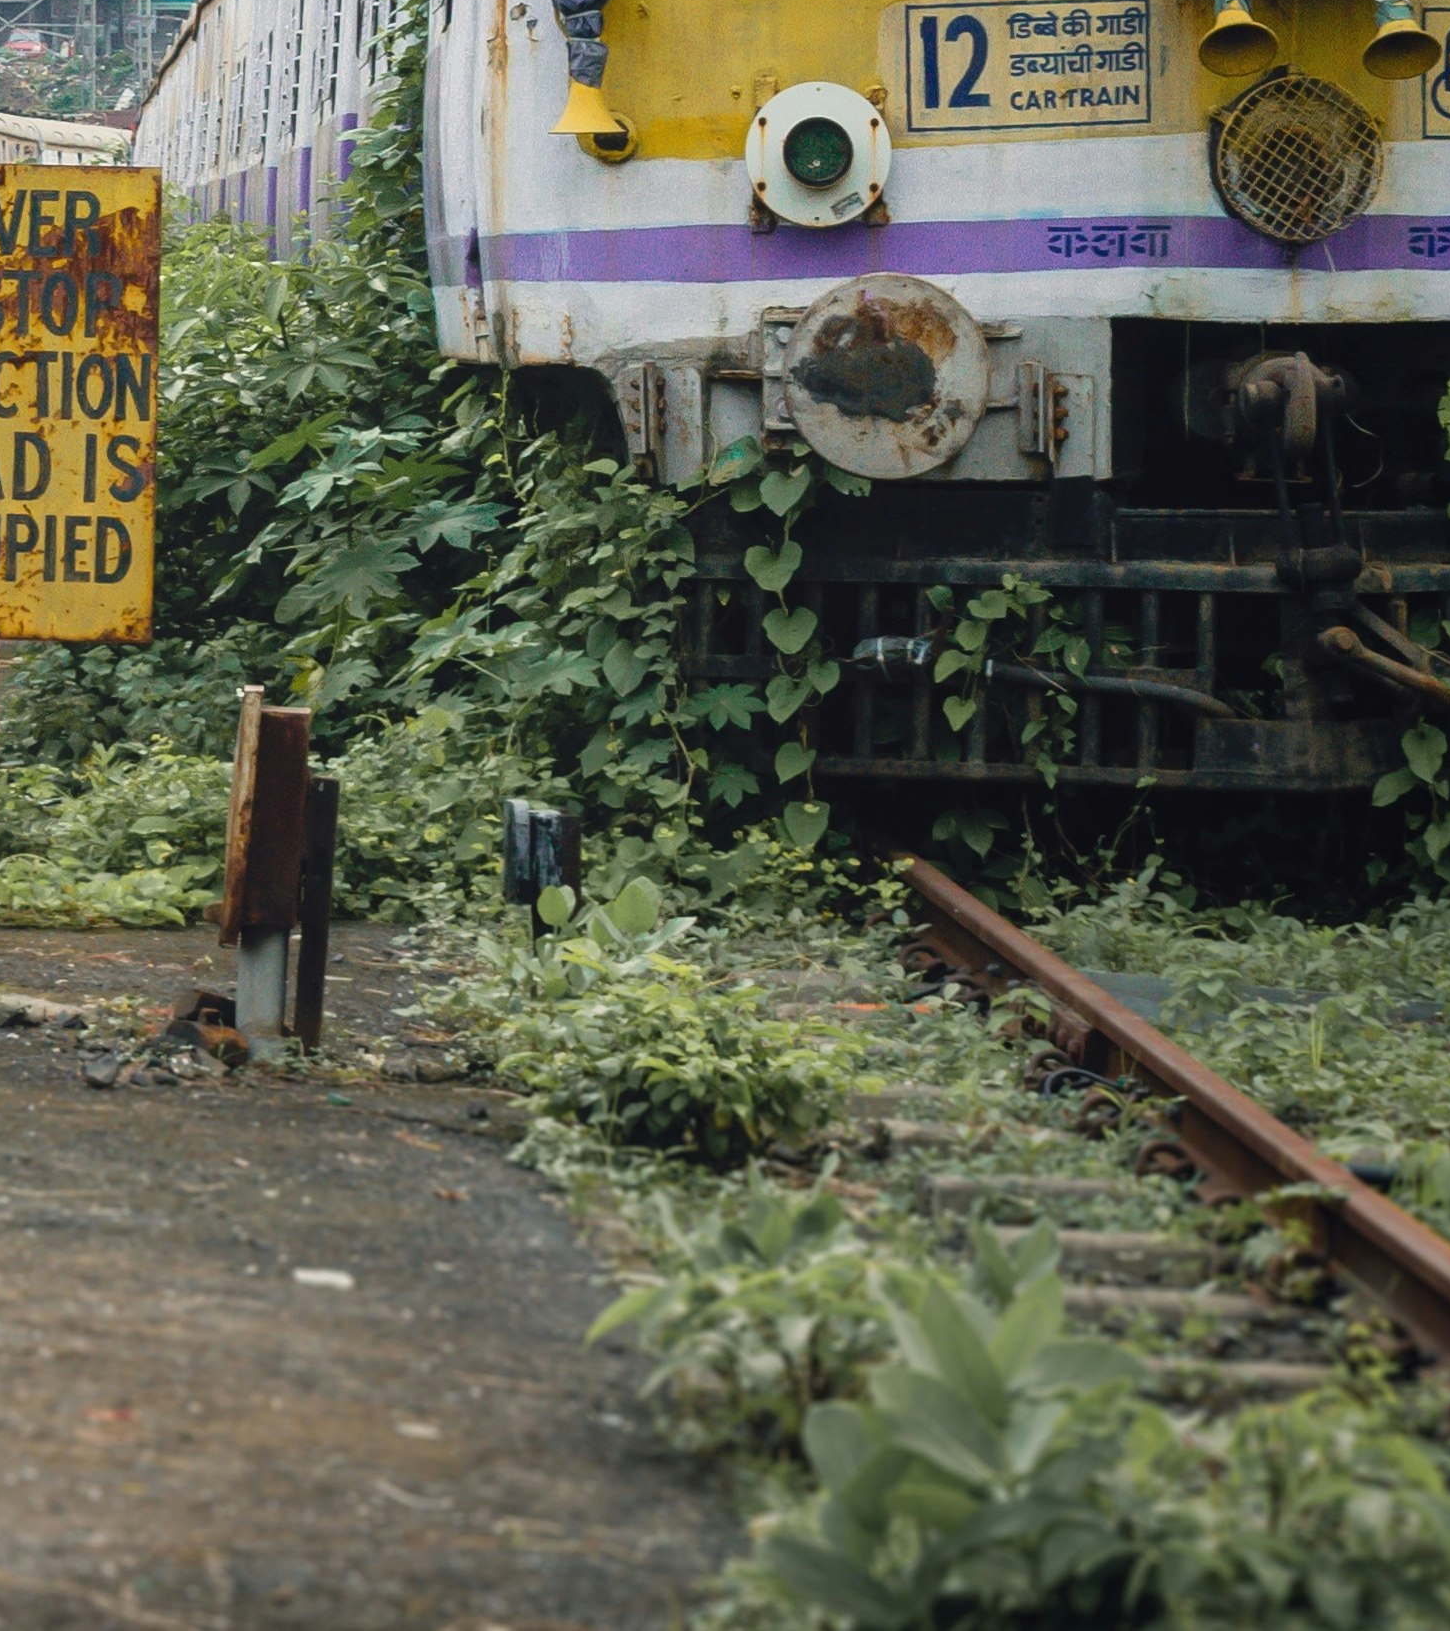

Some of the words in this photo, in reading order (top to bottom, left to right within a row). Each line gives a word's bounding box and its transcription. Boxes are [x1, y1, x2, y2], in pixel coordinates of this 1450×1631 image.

[1062, 8, 1092, 38] की
[920, 14, 991, 109] 12
[1010, 89, 1057, 111] CAR
[1061, 85, 1140, 108] TRAIN
[83, 433, 146, 503] IS
